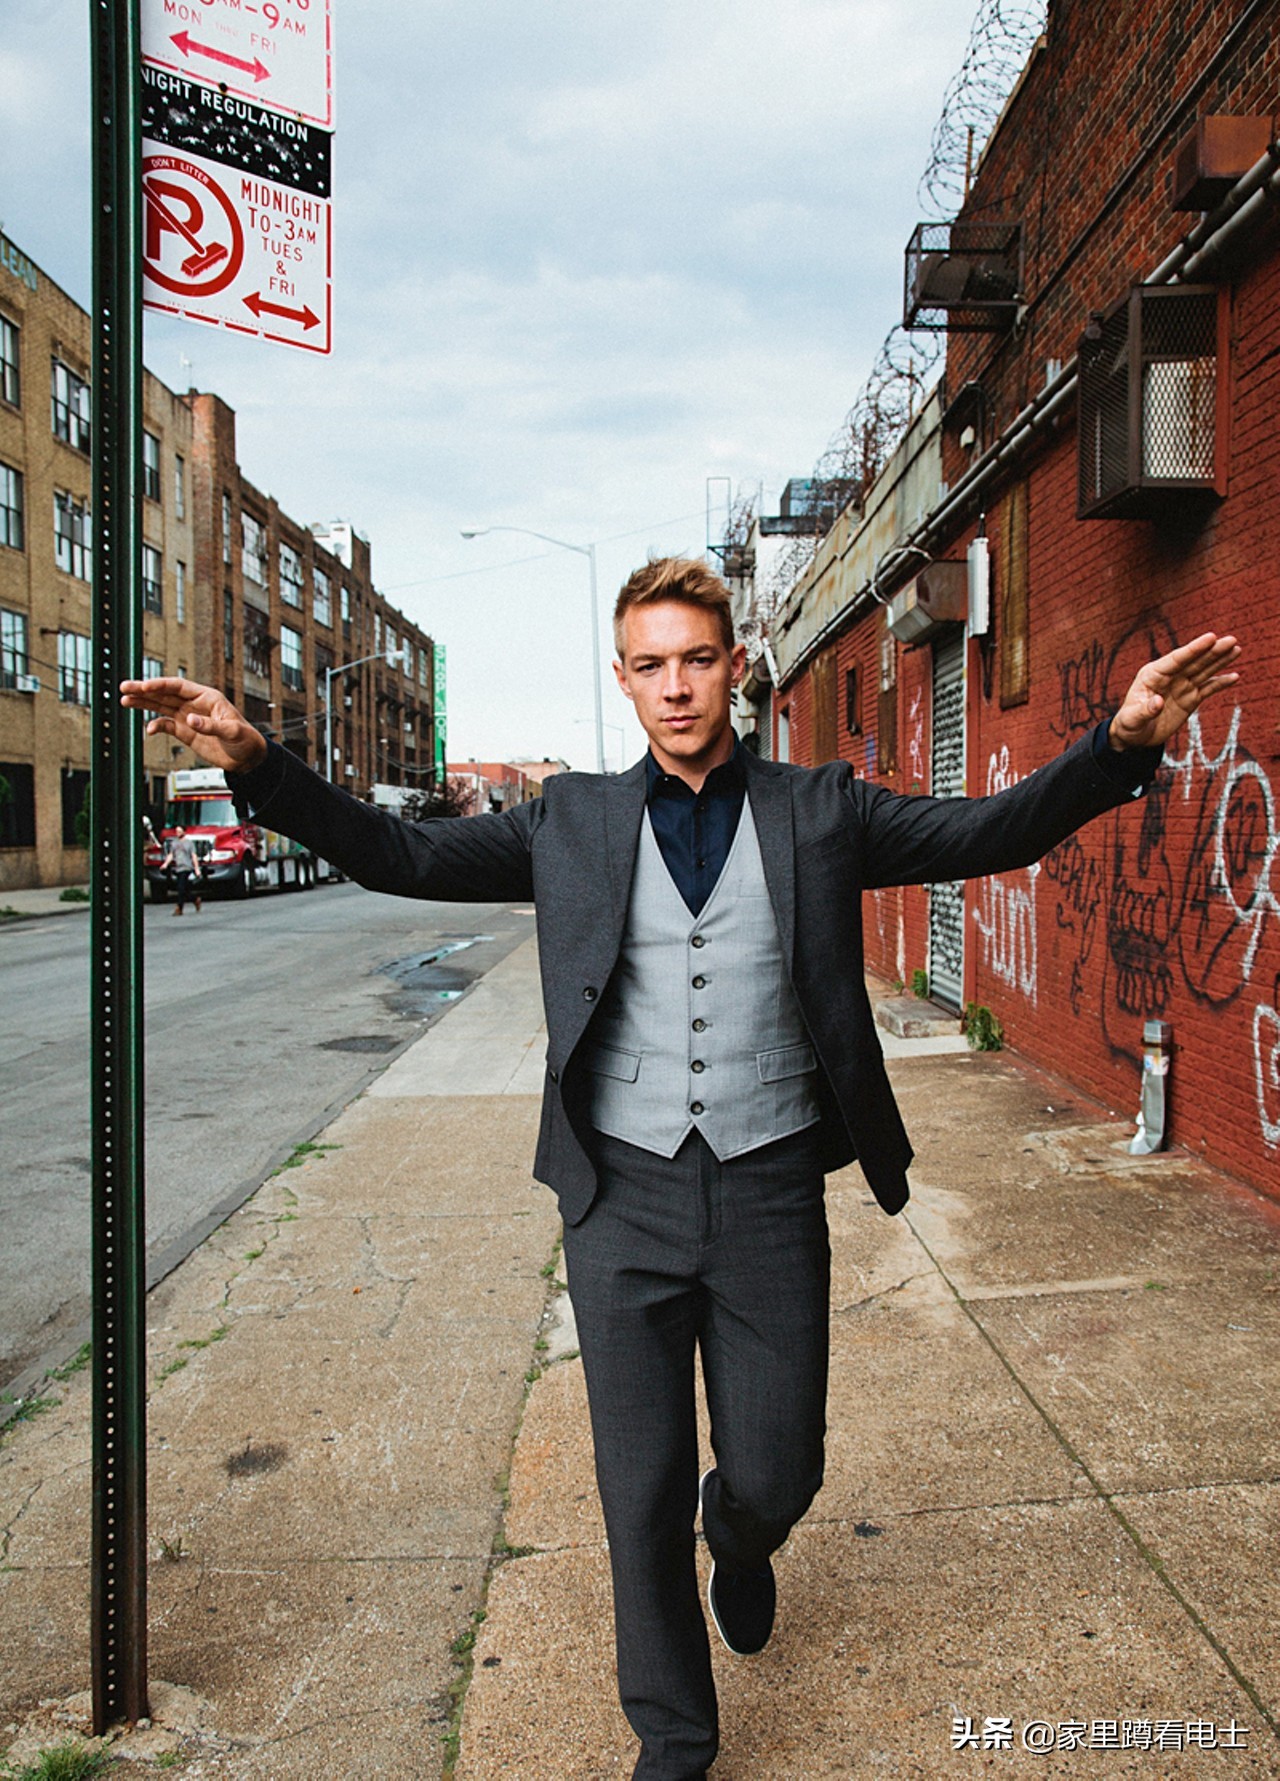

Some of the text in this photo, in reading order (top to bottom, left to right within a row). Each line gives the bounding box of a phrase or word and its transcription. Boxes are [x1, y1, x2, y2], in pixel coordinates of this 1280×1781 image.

[163, 1, 202, 26] MON
[250, 33, 277, 54] FRI
[201, 89, 308, 142] REGULATION
[180, 163, 210, 184] LITTER
[241, 178, 321, 224] MIDNIGHT
[262, 236, 303, 262] TUES
[276, 260, 287, 276] &
[269, 276, 295, 296] FRI
